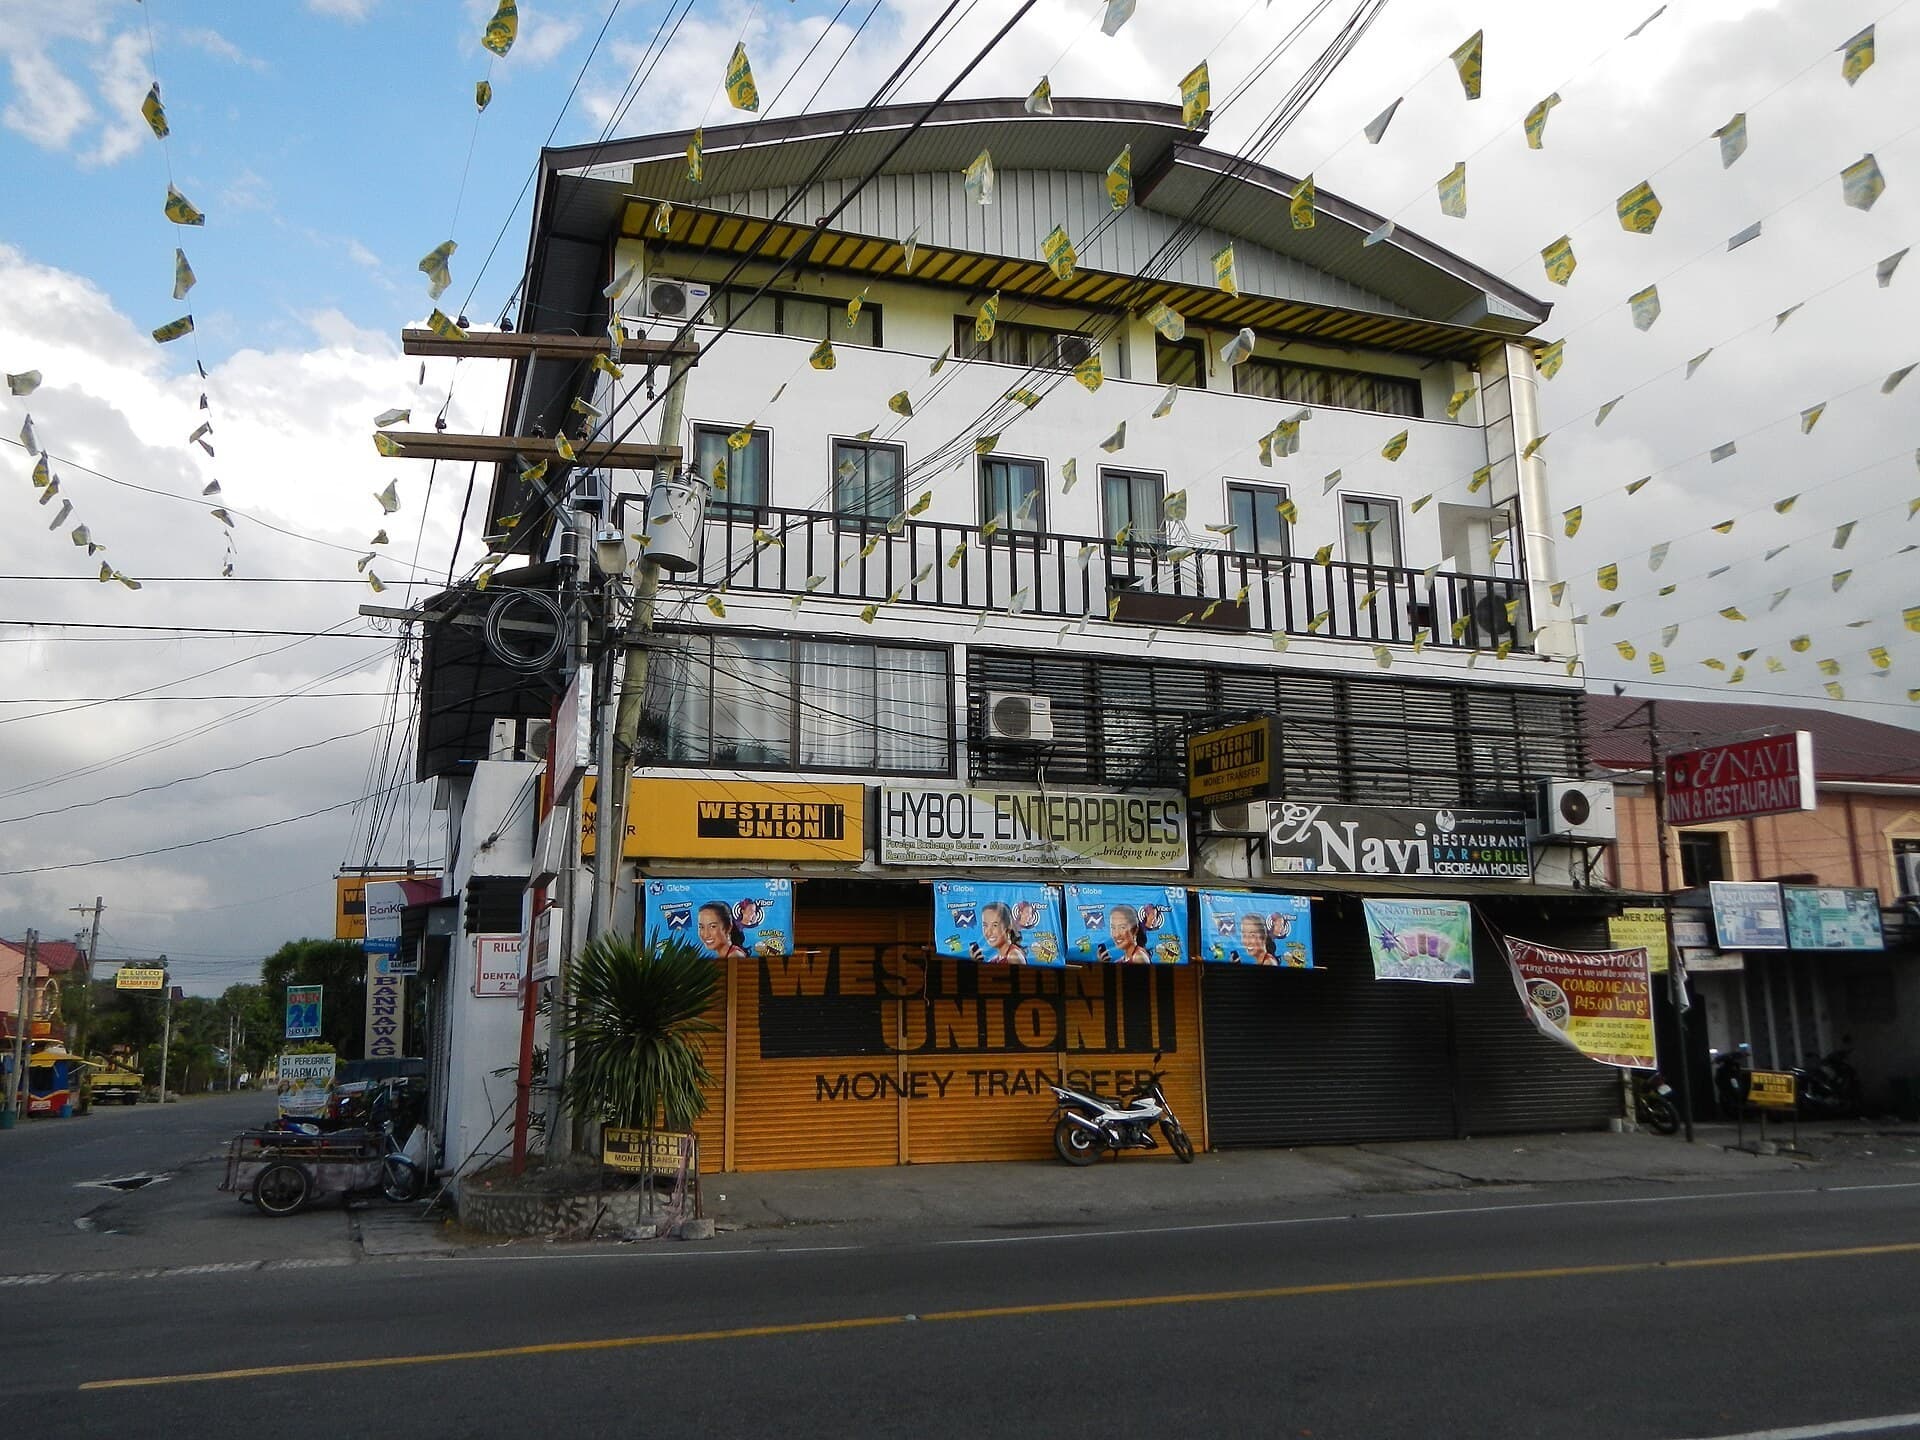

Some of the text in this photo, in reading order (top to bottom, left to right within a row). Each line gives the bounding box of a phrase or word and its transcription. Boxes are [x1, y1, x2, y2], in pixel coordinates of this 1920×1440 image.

[1195, 733, 1252, 760] WESTERN
[1212, 749, 1252, 772] UNION
[1729, 742, 1795, 780] NAVI
[1203, 768, 1260, 787] MONEY TRANSFER
[1235, 788, 1254, 798] HERE
[1704, 775, 1799, 816] RESTAURANT
[699, 802, 820, 821] WESTERN
[887, 791, 1181, 845] HYBOL ENTERPRISES
[738, 821, 820, 838] UNION
[1312, 820, 1434, 873] Navi
[1432, 834, 1526, 848] RESTAURANT
[1144, 847, 1158, 857] the
[1161, 848, 1181, 861] gap!
[1433, 847, 1527, 862] BAR GRILL
[1434, 862, 1529, 876] ICECREAM HOUSE
[666, 884, 691, 892] Globe
[953, 885, 975, 893] Globe
[1082, 887, 1103, 895] Globe
[755, 899, 774, 907] Viber
[1544, 965, 1577, 976] October
[1562, 978, 1648, 994] COMBO MEALS
[289, 993, 320, 1004] OPEN
[288, 1004, 319, 1028] 24
[370, 976, 398, 1057] BANNAWAG
[880, 1000, 1107, 1051] UNION
[294, 1056, 331, 1066] PEREGRINE
[281, 1066, 333, 1079] PHARMACY
[816, 1071, 955, 1101] MONEY
